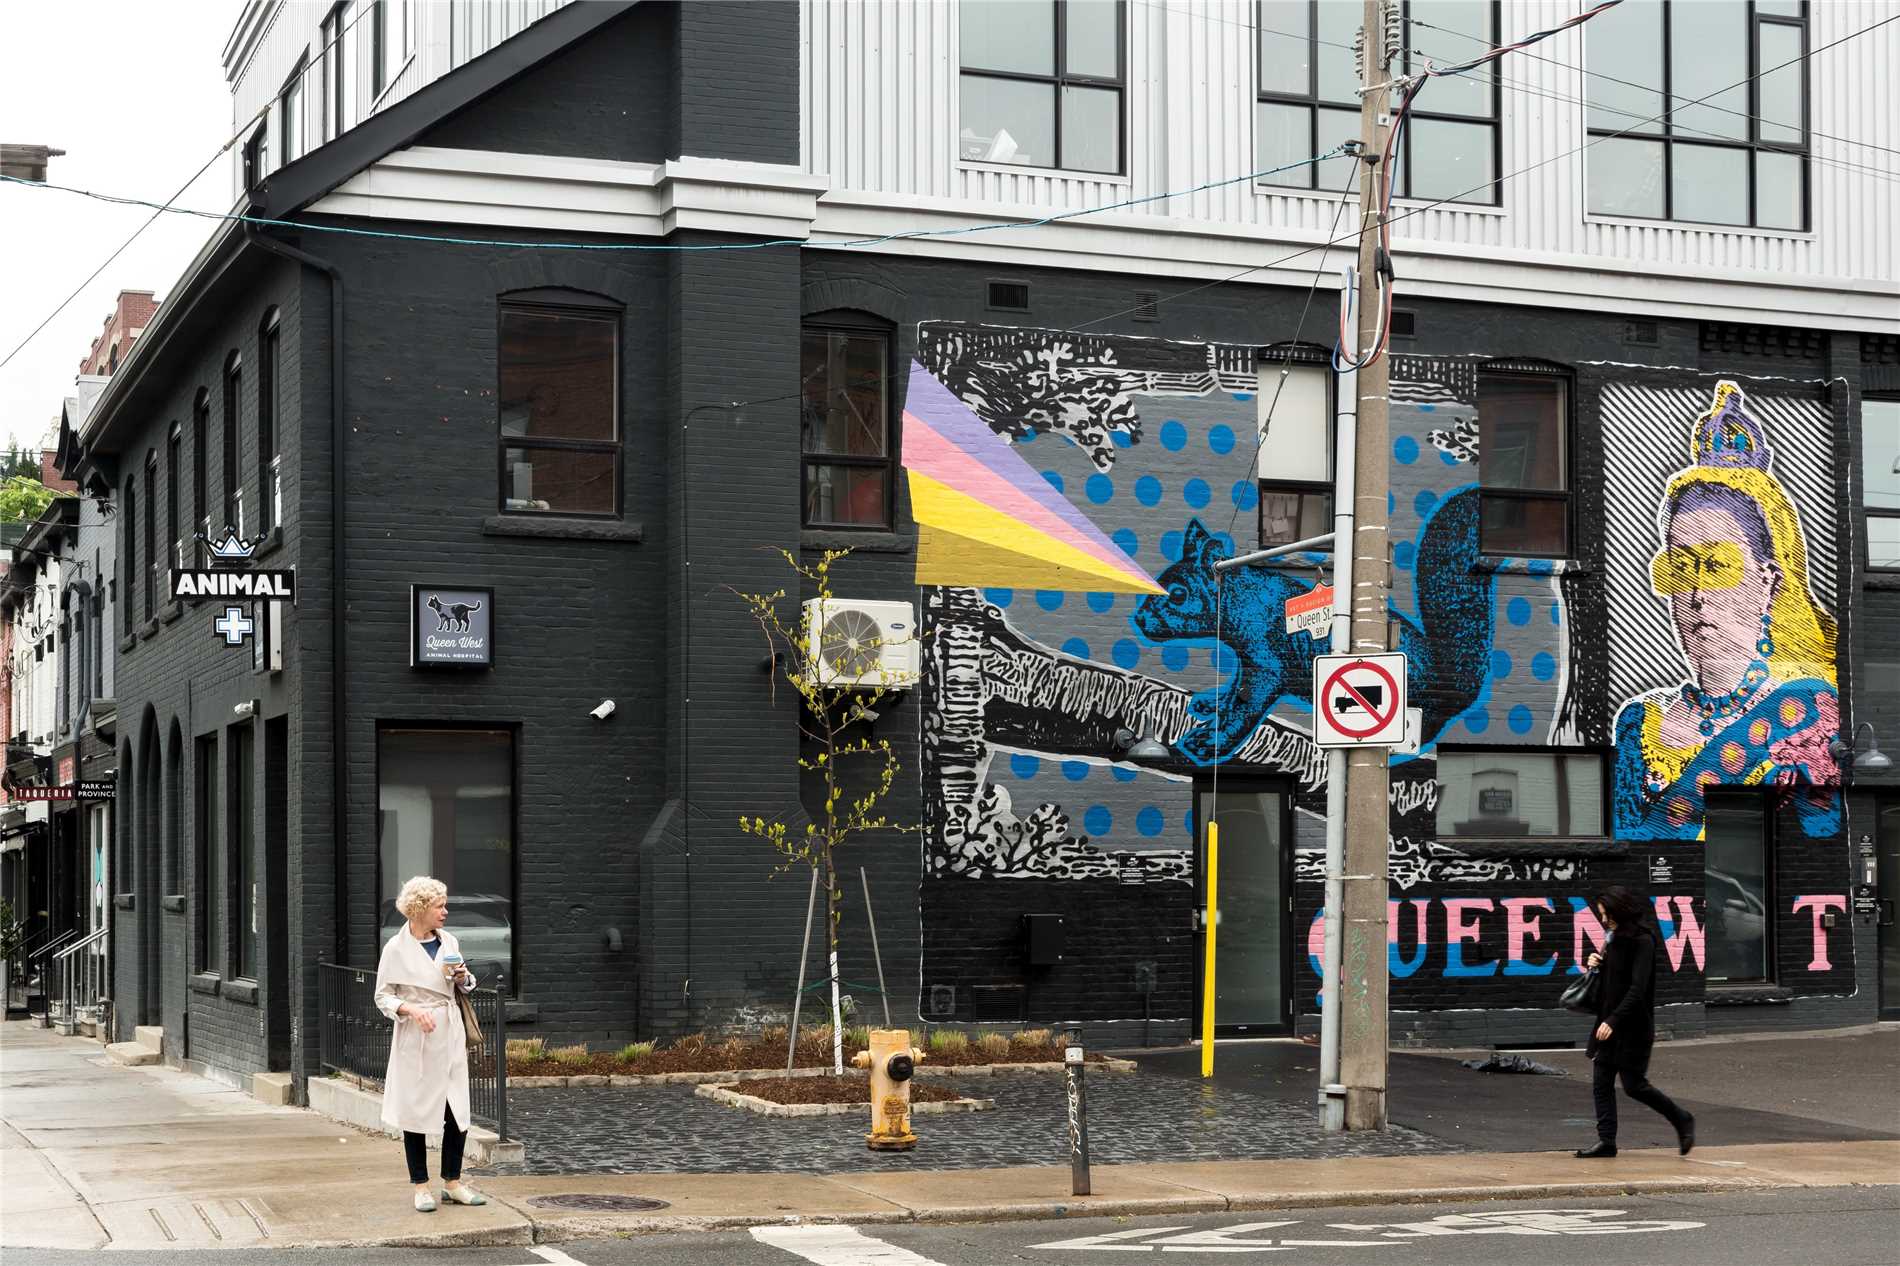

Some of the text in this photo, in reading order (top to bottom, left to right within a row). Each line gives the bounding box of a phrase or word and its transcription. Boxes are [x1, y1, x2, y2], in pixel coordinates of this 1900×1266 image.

[176, 573, 291, 596] ANIMAL
[1297, 607, 1330, 629] Queen St
[1316, 627, 1325, 636] 931
[426, 635, 484, 650] Queen West
[19, 788, 73, 798] TAQUERIA
[78, 790, 117, 798] PROVINCE
